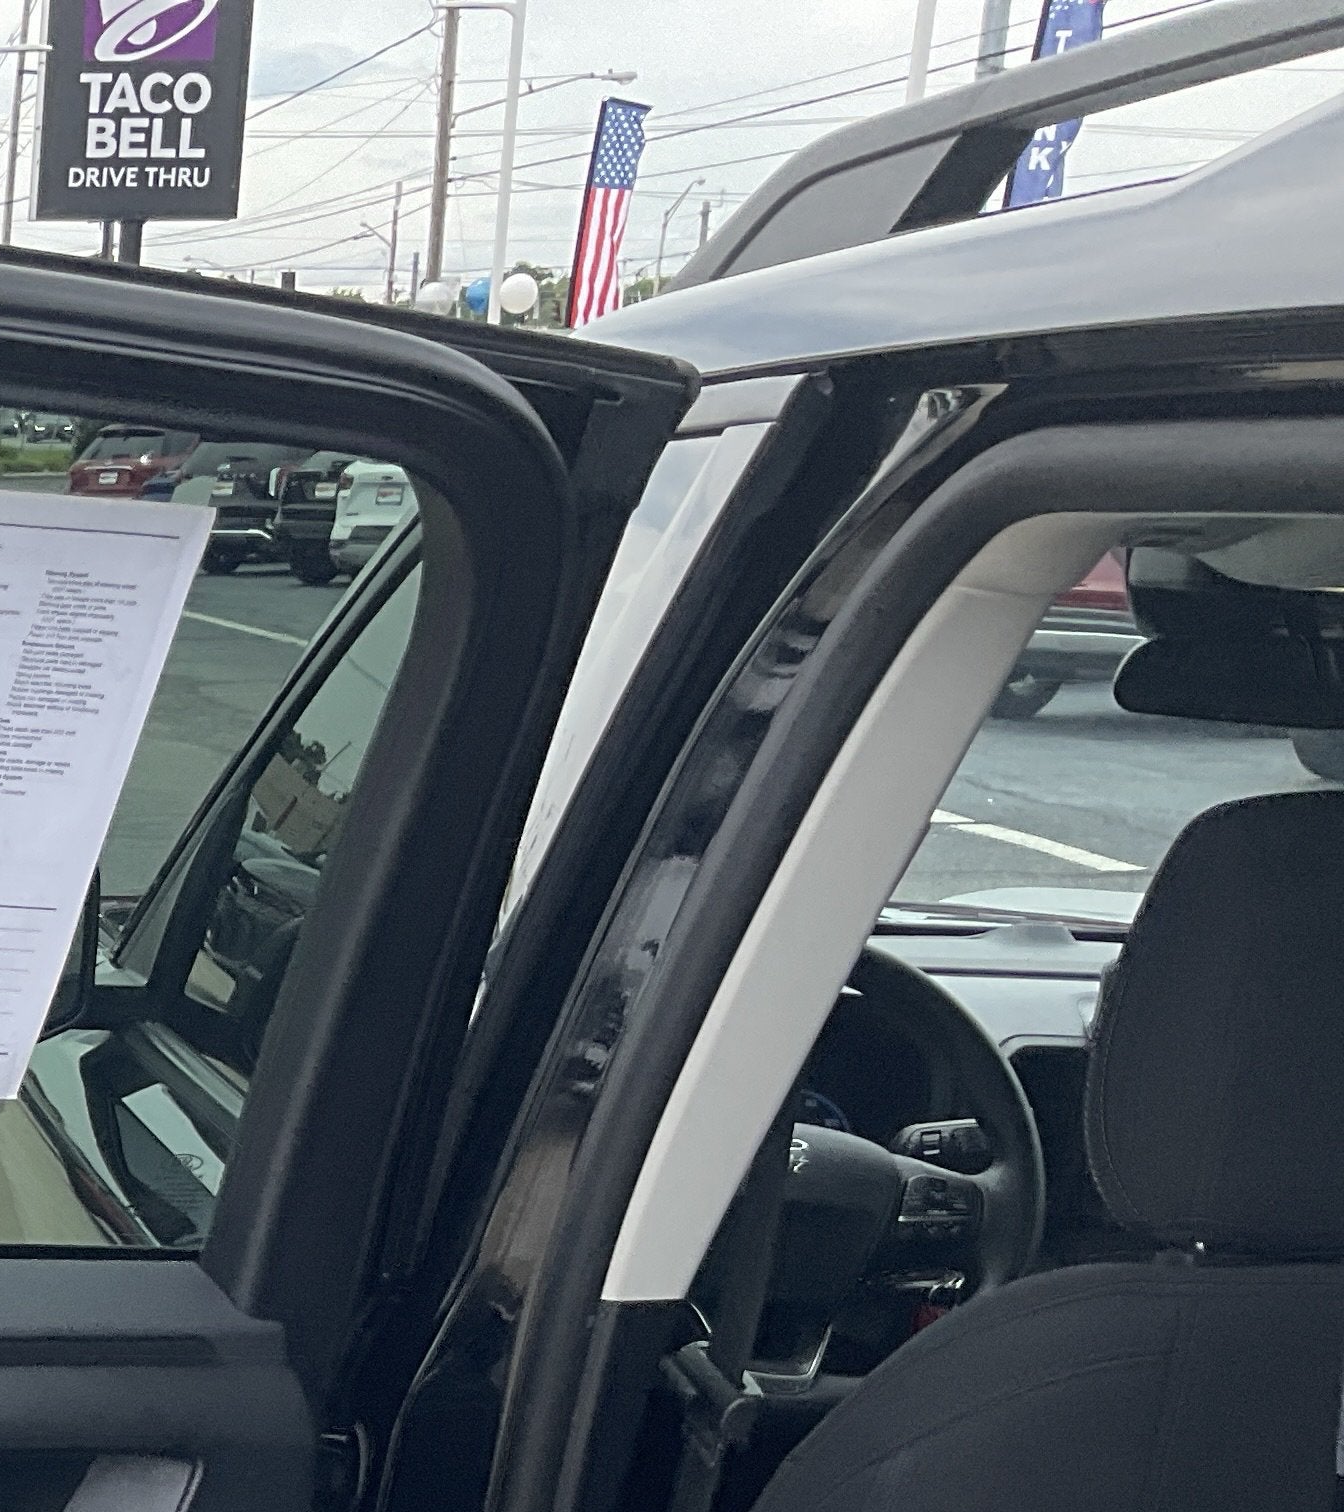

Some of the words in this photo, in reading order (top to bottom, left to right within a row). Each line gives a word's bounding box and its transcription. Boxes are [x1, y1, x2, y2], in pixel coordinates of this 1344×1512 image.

[79, 72, 212, 114] TACO
[85, 117, 206, 159] BELL
[68, 166, 139, 188] DRIVE
[144, 166, 211, 188] THRU
